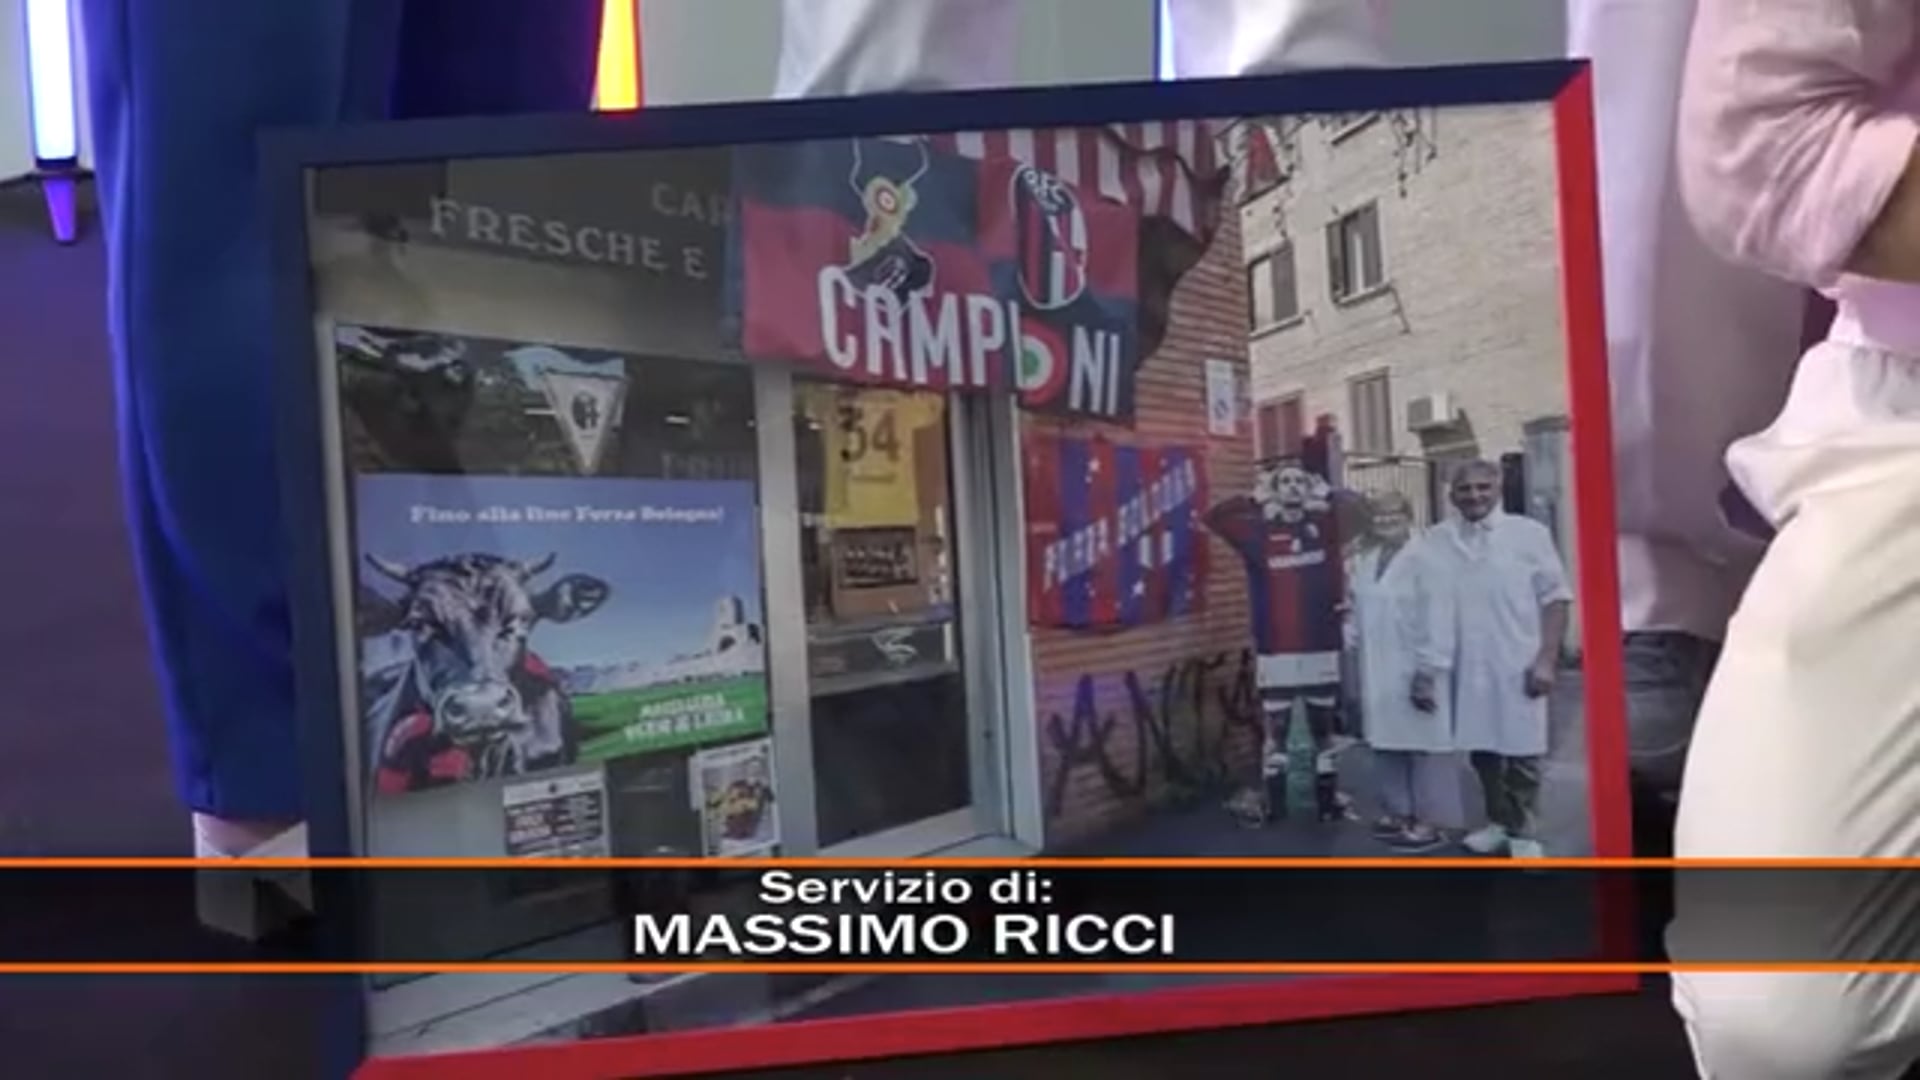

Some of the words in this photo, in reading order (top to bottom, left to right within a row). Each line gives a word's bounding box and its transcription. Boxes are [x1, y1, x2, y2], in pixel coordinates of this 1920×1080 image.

[429, 197, 667, 271] FRESCHE
[684, 247, 708, 280] E
[839, 406, 899, 463] 34
[410, 505, 471, 523] Fino
[476, 506, 521, 522] alla
[575, 505, 637, 521] Forza
